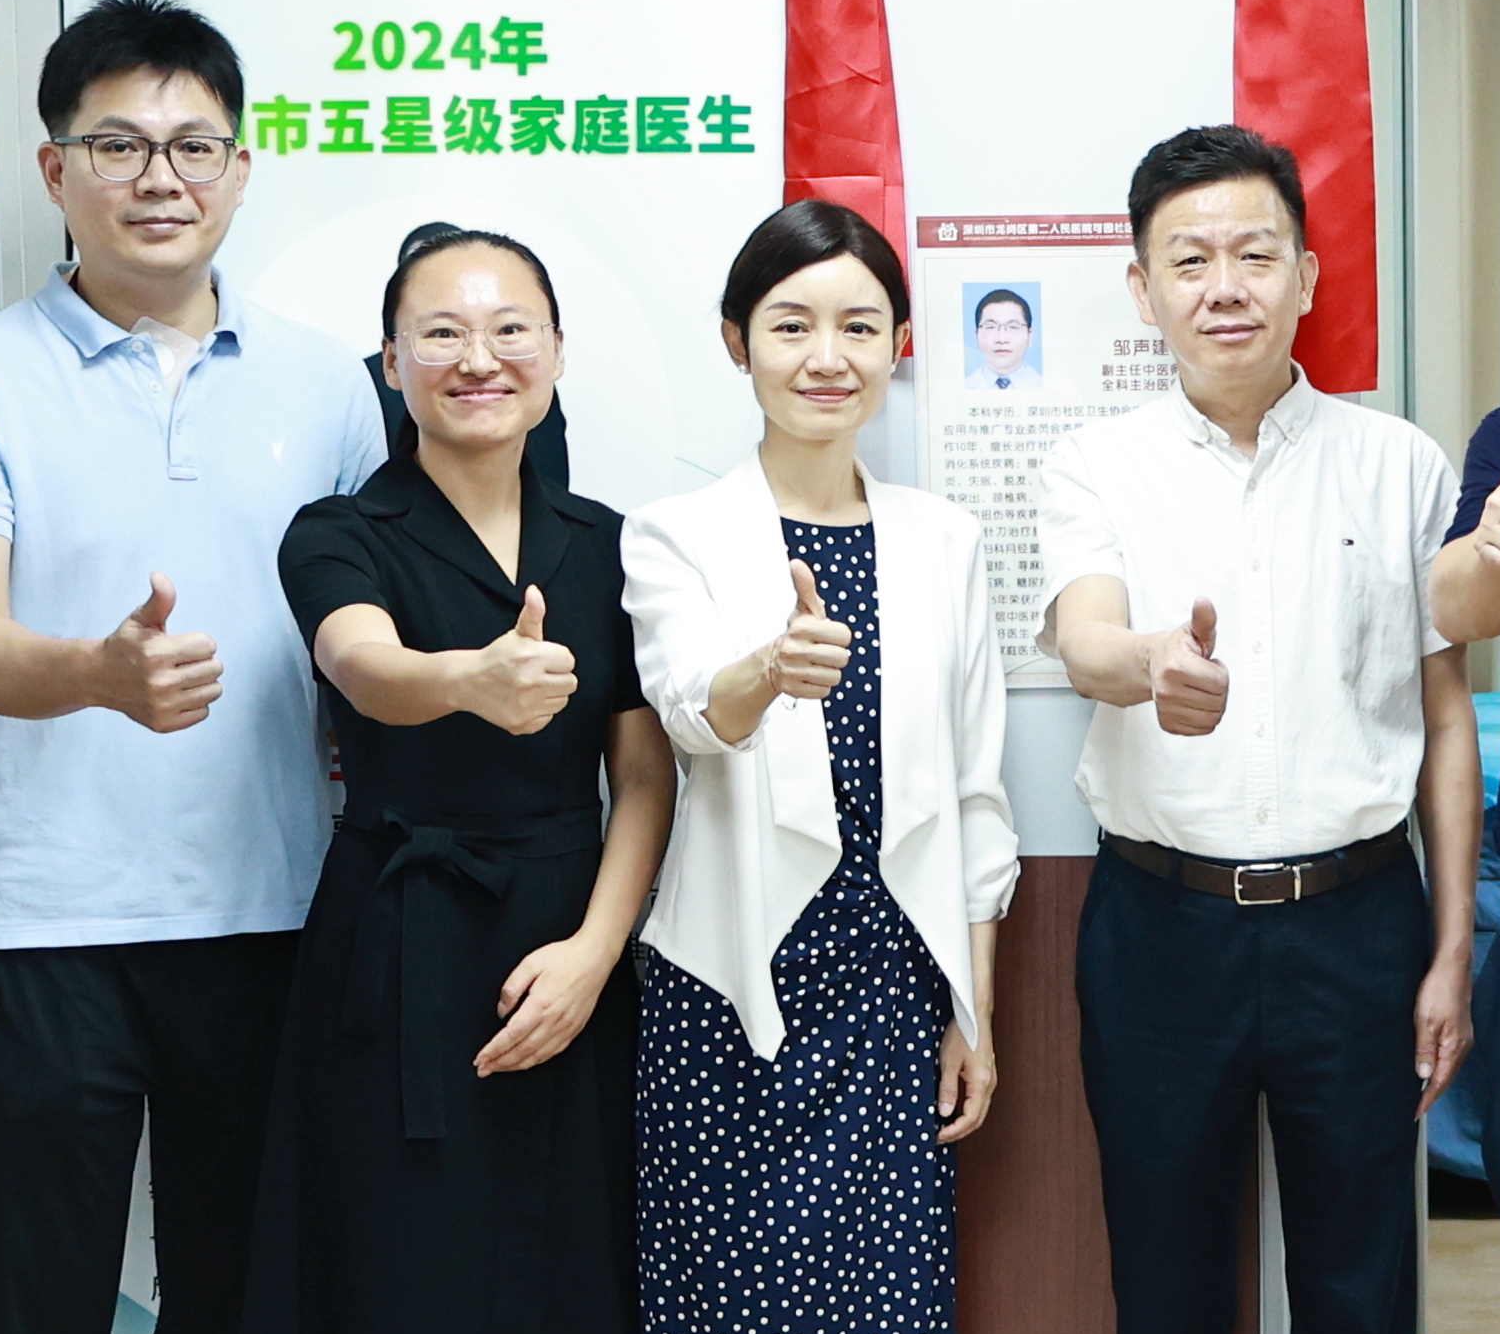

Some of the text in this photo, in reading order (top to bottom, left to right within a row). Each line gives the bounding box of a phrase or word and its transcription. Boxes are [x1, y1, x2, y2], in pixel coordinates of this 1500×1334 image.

[331, 16, 549, 77] 2024年
[242, 94, 756, 155] 市五星级家庭医生
[1113, 338, 1170, 357] 邹声建
[968, 404, 1140, 418] 本科学历，深圳市社区卫生协会
